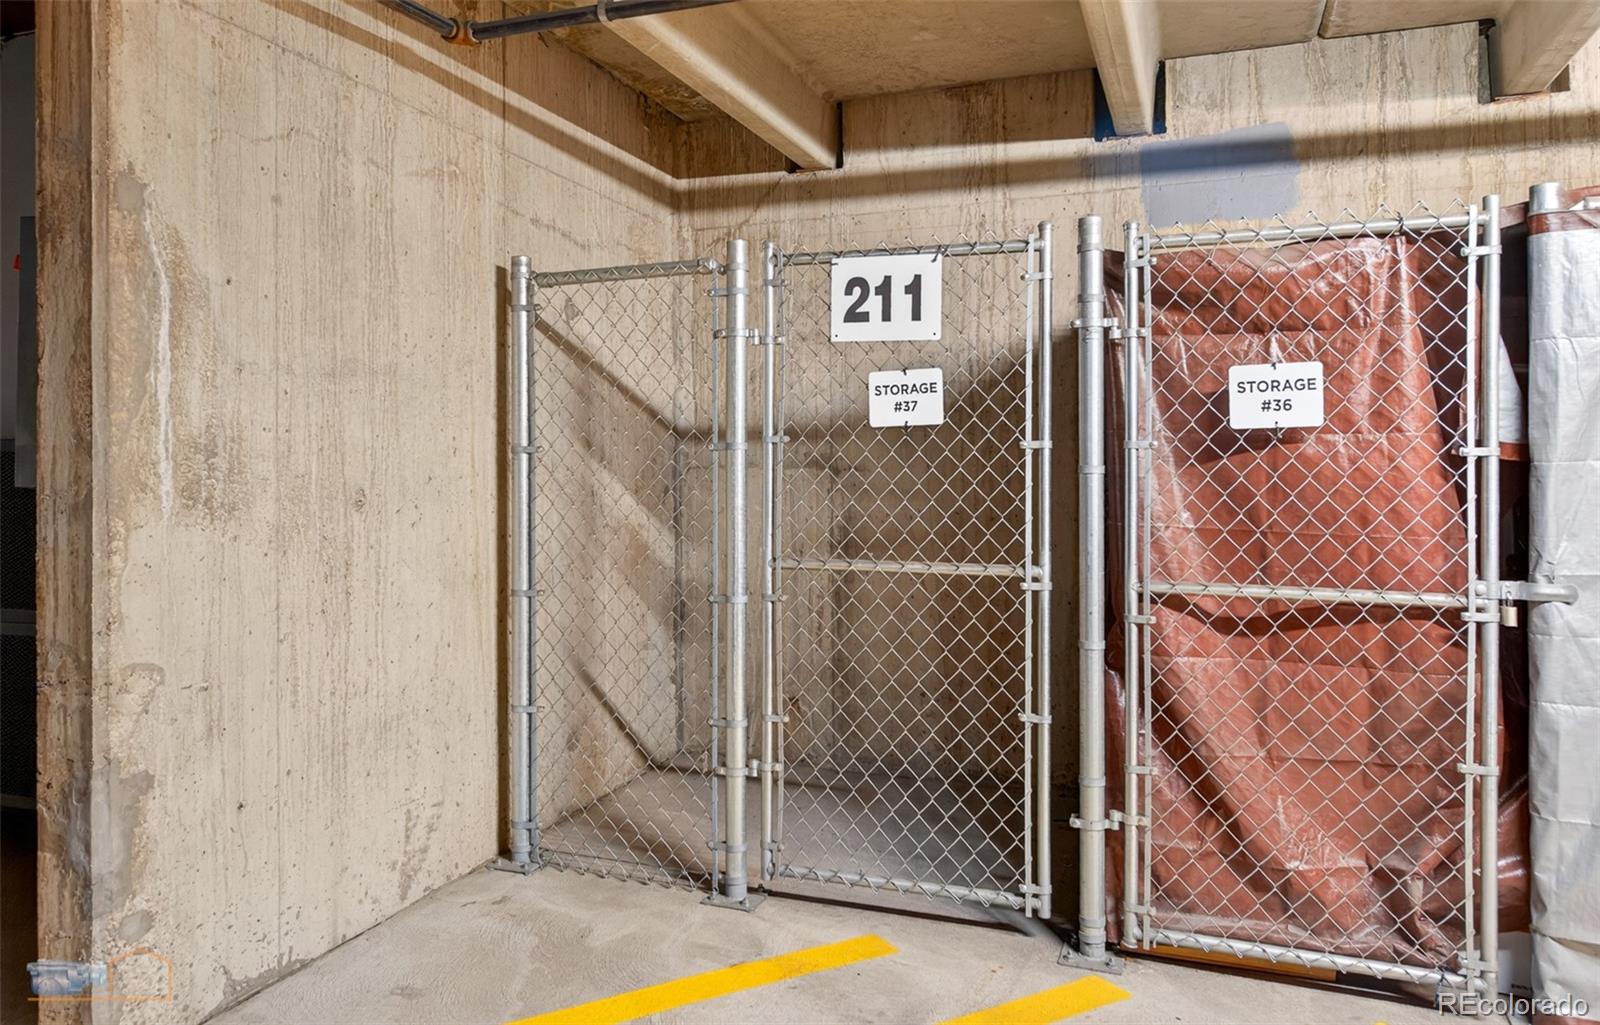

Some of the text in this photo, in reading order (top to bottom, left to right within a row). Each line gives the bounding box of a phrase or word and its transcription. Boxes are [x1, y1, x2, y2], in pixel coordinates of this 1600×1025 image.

[843, 274, 922, 323] 211
[874, 382, 938, 396] STORAGE
[1236, 378, 1317, 394] STORAGE
[893, 400, 918, 413] #37
[1261, 398, 1293, 412] #36
